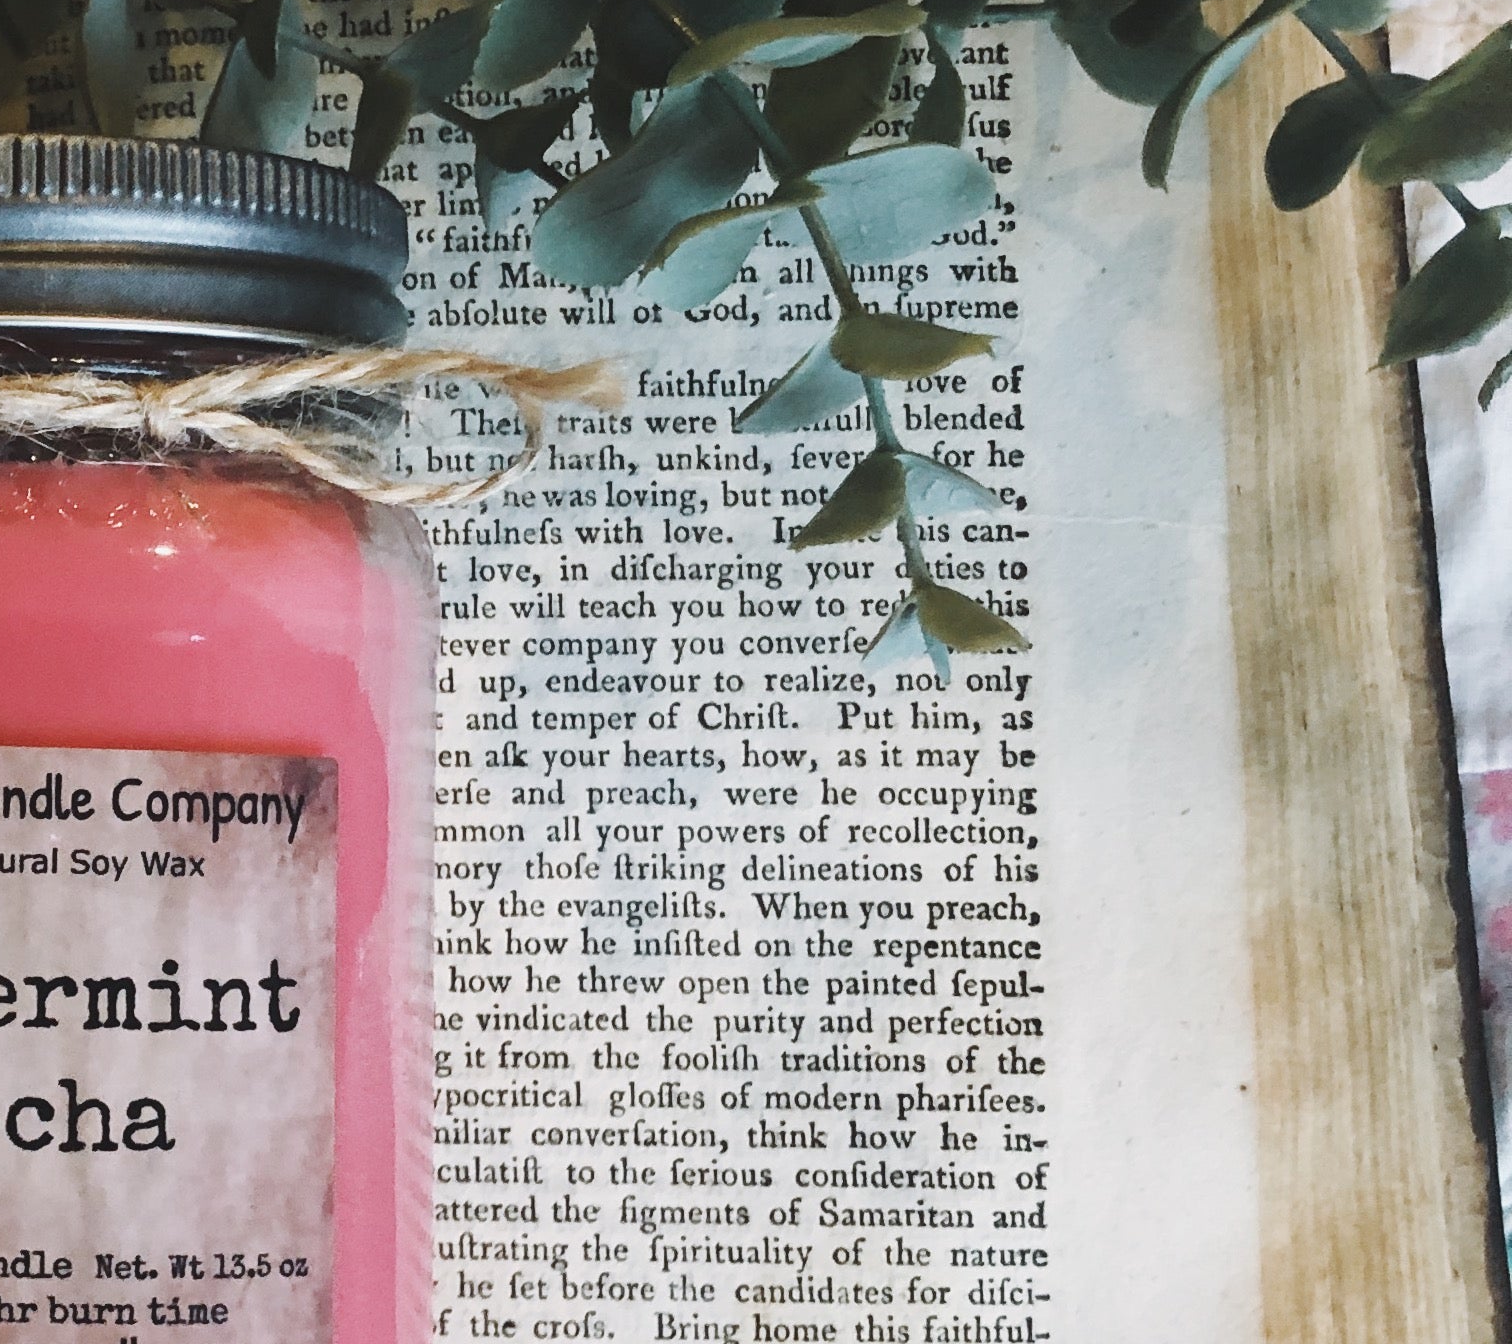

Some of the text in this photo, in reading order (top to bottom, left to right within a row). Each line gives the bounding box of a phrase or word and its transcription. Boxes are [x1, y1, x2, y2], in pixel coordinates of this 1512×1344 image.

[557, 407, 717, 436] traits were
[440, 589, 846, 628] rule will teach you how to
[111, 771, 312, 845] Company
[546, 813, 1039, 853] all your powers of recollection,
[69, 848, 129, 883] Soy
[140, 850, 206, 878] Wax
[448, 889, 486, 928] by
[498, 889, 545, 918] the
[750, 890, 850, 921] When
[858, 900, 915, 931] you
[926, 891, 1041, 931] preach,
[551, 1195, 1048, 1235] the figments of Samaritan and
[93, 1253, 159, 1282] Net.
[167, 1254, 206, 1281] Wt
[212, 1252, 272, 1281] 13.5
[278, 1256, 310, 1278] oz
[46, 1294, 139, 1326] burn
[146, 1296, 229, 1327] time
